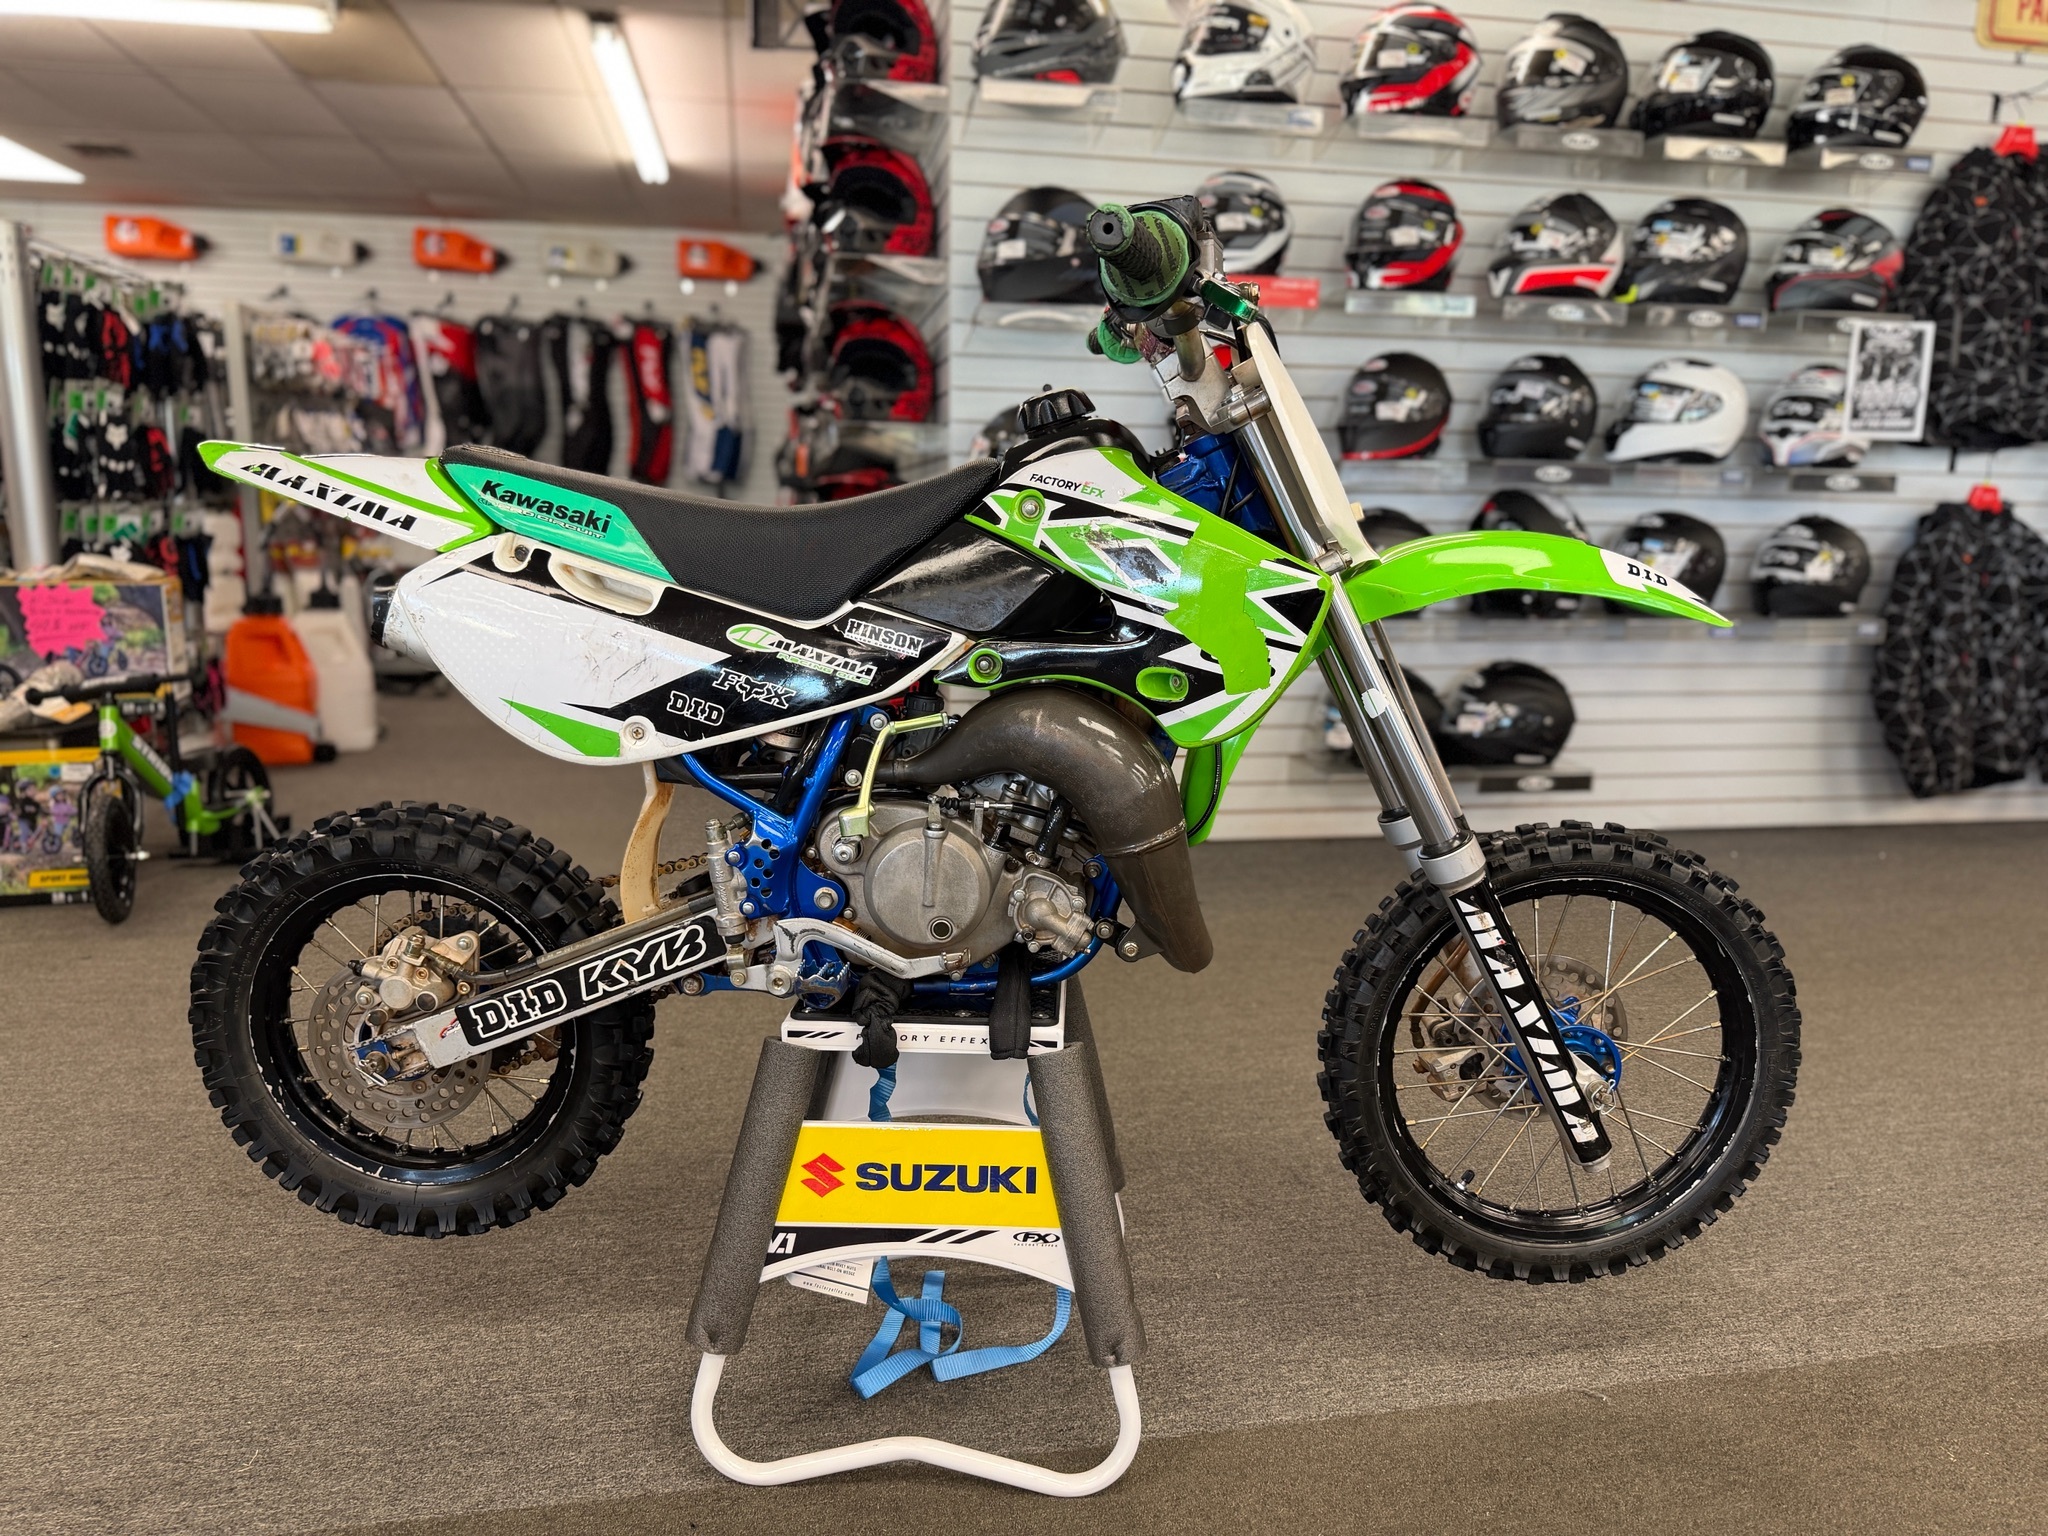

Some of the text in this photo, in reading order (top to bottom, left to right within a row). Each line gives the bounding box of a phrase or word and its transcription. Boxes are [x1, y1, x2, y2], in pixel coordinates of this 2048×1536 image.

[240, 463, 418, 532] MAXIMA
[481, 479, 613, 534] Kawasaki
[535, 514, 606, 540] CIRCUIT
[1626, 562, 1668, 587] D.I.D
[845, 619, 924, 653] HINSON
[768, 637, 878, 679] MAXIMA
[776, 652, 873, 686] RACING OILS
[712, 667, 797, 710] FOX
[667, 690, 726, 727] D.I.D
[469, 978, 568, 1040] D.I.D
[579, 924, 708, 1002] KYB
[855, 1033, 989, 1046] FORY EFFEX
[1455, 898, 1600, 1144] MAXIMA
[855, 1161, 1038, 1195] SUZUKI
